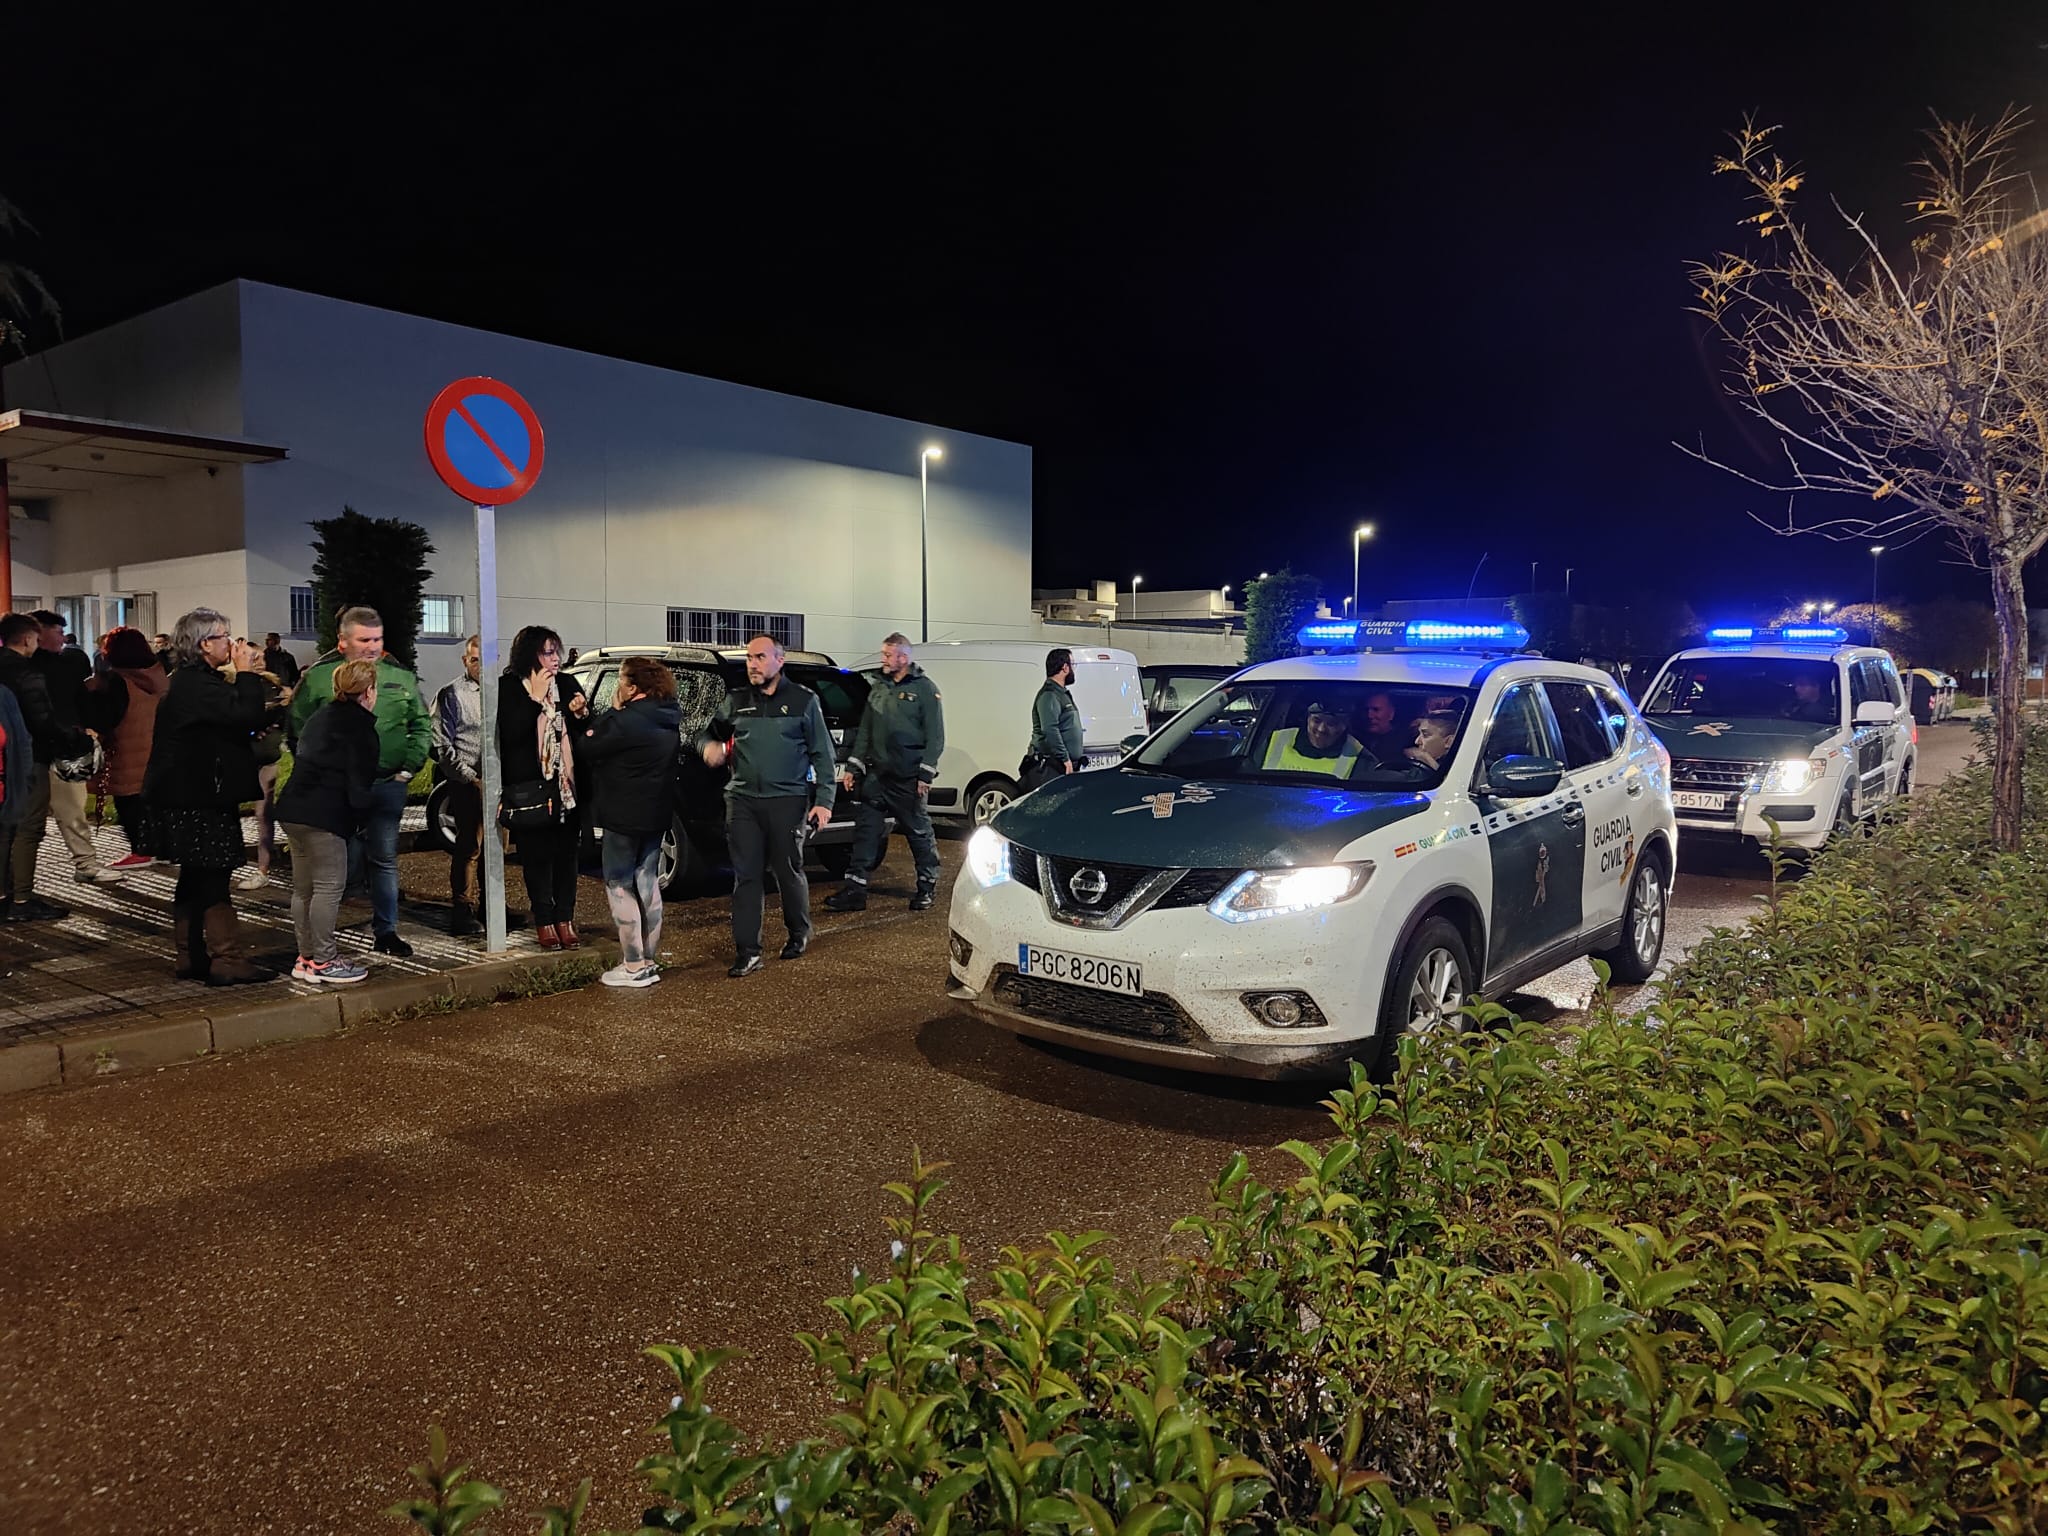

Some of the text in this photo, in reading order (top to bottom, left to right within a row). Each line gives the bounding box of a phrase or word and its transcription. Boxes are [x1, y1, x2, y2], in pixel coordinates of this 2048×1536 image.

[1418, 831, 1453, 849] GUAA
[1593, 814, 1632, 848] GUARDIA
[1601, 846, 1622, 873] CIVIL
[1030, 949, 1141, 993] PGC8206N
